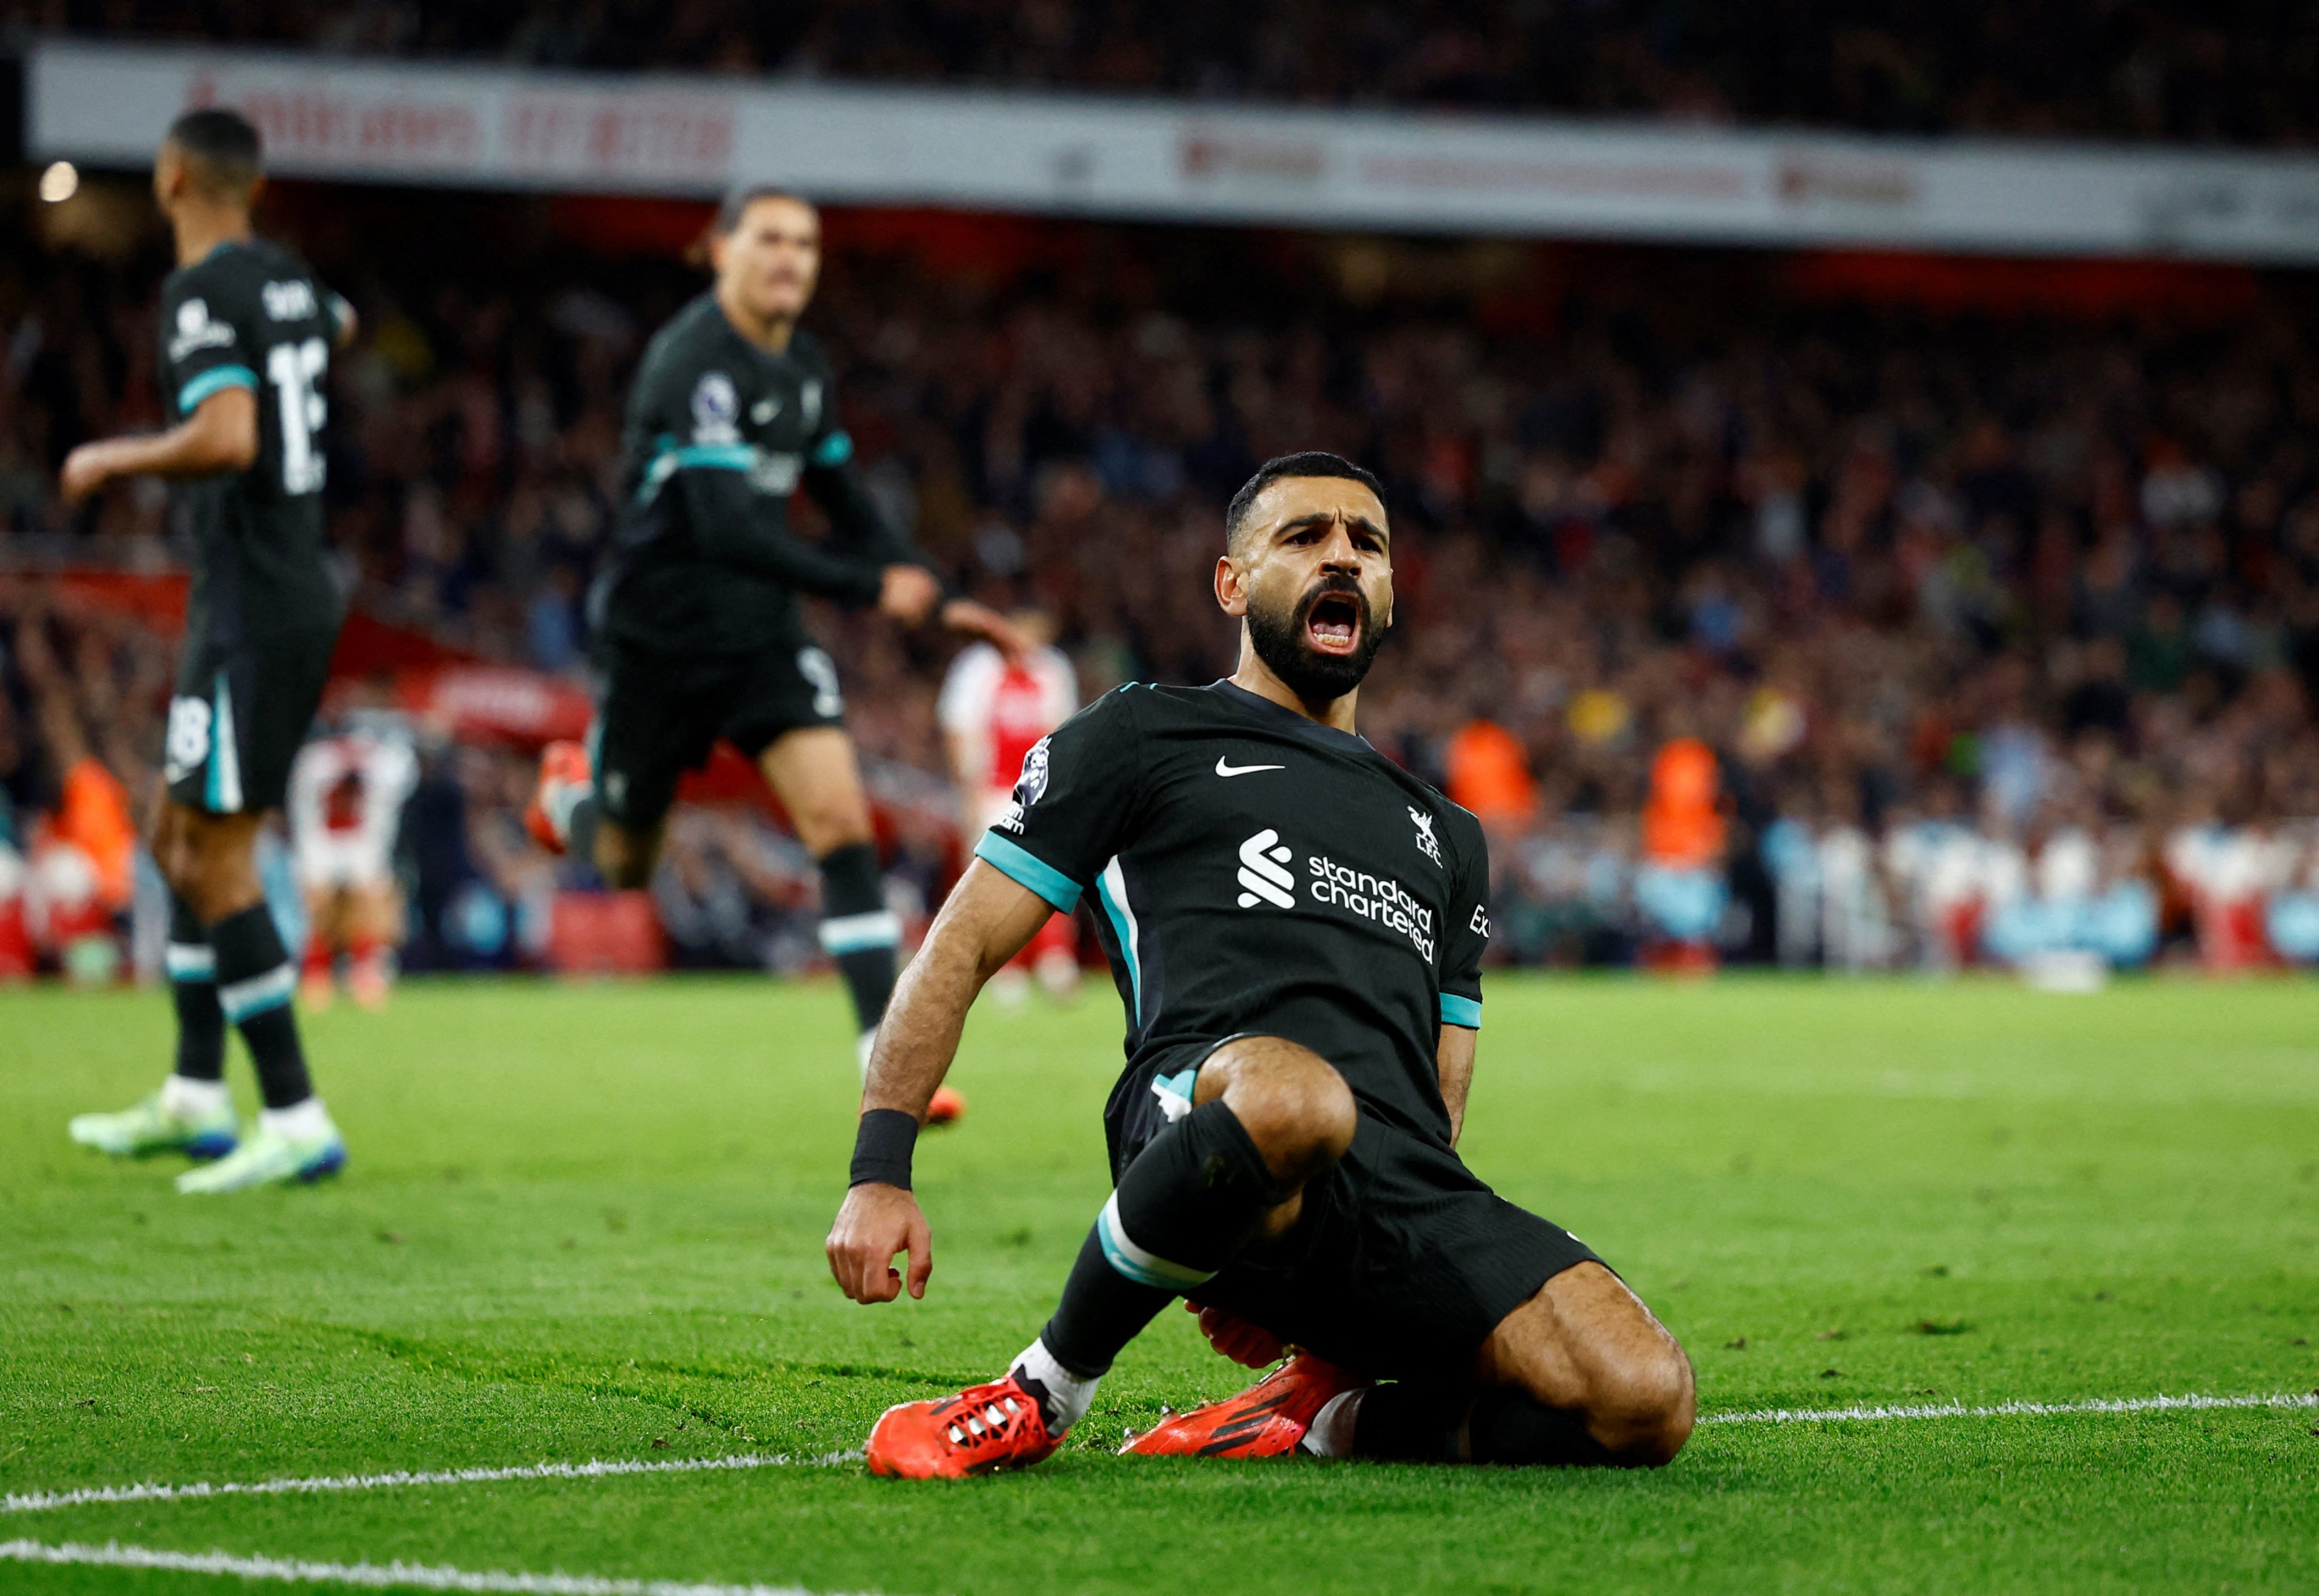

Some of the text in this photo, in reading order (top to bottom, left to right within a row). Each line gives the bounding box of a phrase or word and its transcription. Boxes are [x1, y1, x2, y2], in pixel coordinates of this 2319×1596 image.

[1309, 856, 1432, 934] standard
[1310, 880, 1434, 965] chartered
[1469, 904, 1491, 938] Ex
